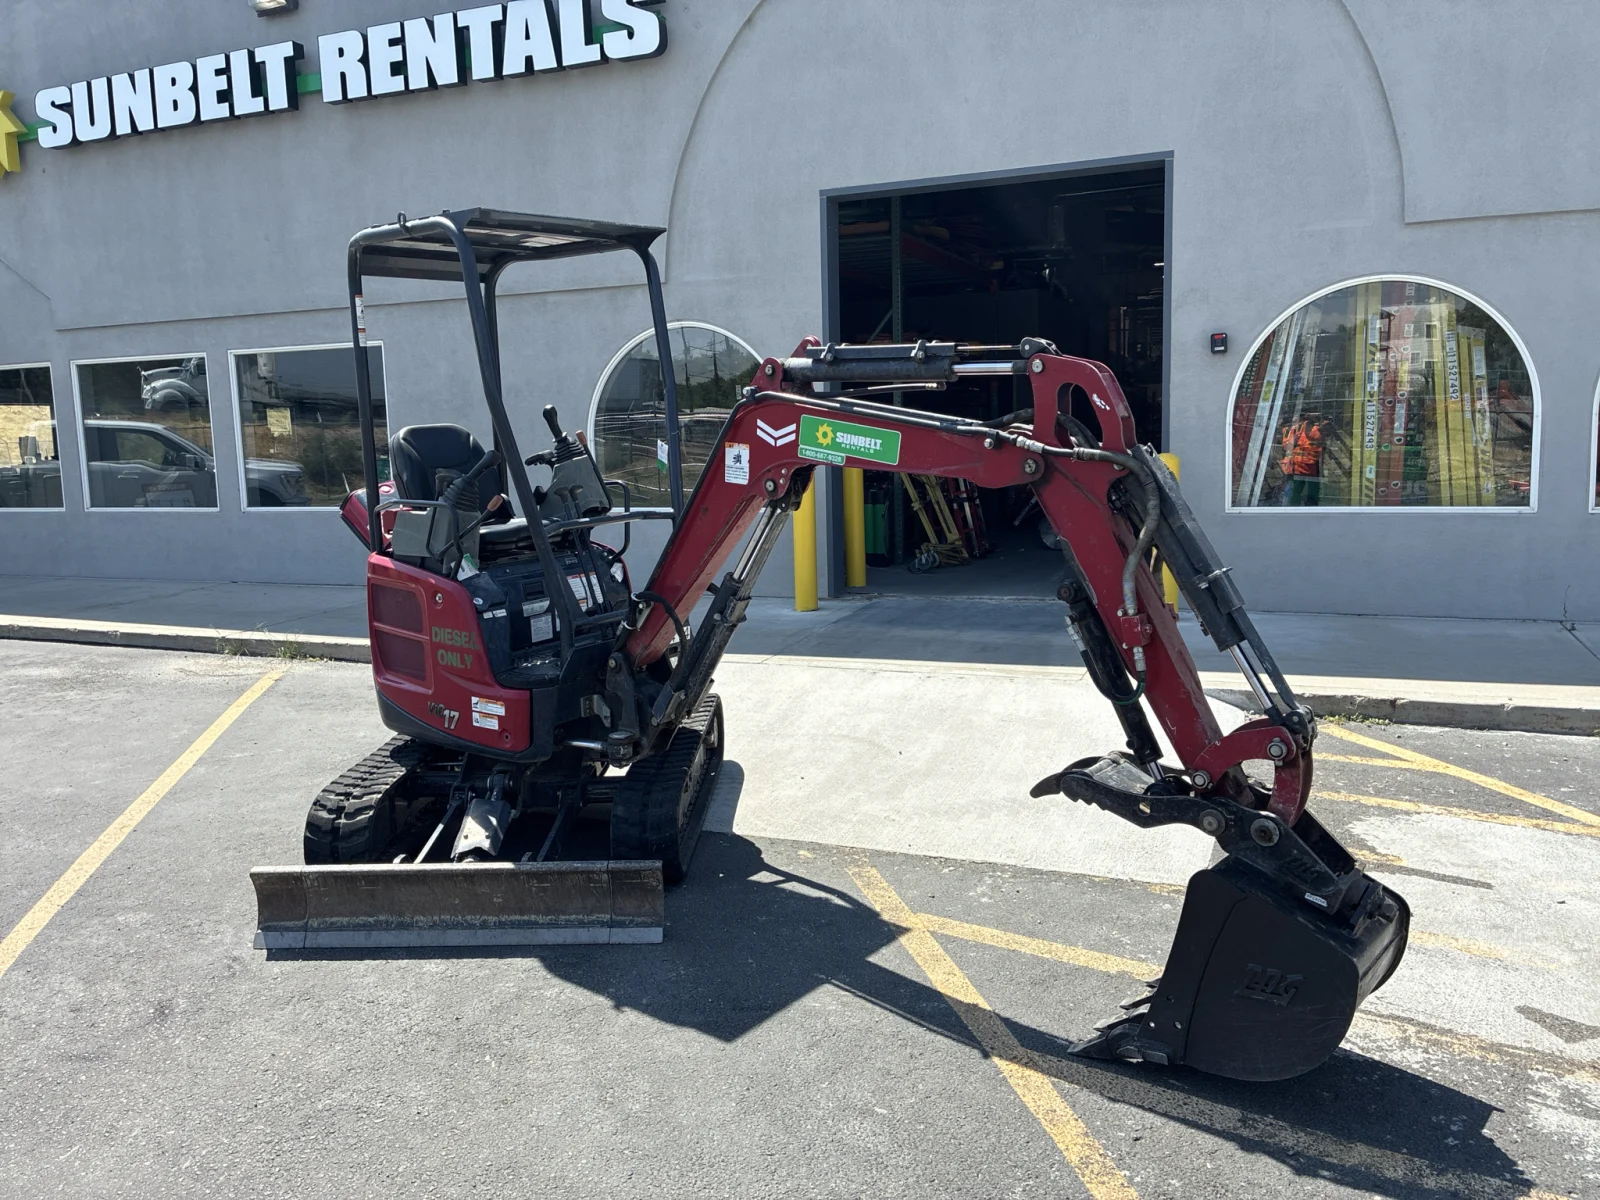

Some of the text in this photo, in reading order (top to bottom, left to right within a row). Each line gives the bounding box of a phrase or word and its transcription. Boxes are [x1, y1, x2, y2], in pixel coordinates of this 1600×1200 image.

[34, 0, 666, 149] SUNBELT RENTALS
[1448, 352, 1459, 401] 11527492
[1365, 403, 1376, 450] 11527493
[836, 432, 882, 450] SUNBELT
[841, 443, 874, 454] RENTALS
[802, 449, 842, 463] 1-800-667-9328
[431, 626, 480, 650] DIESEL
[437, 648, 473, 670] ONLY
